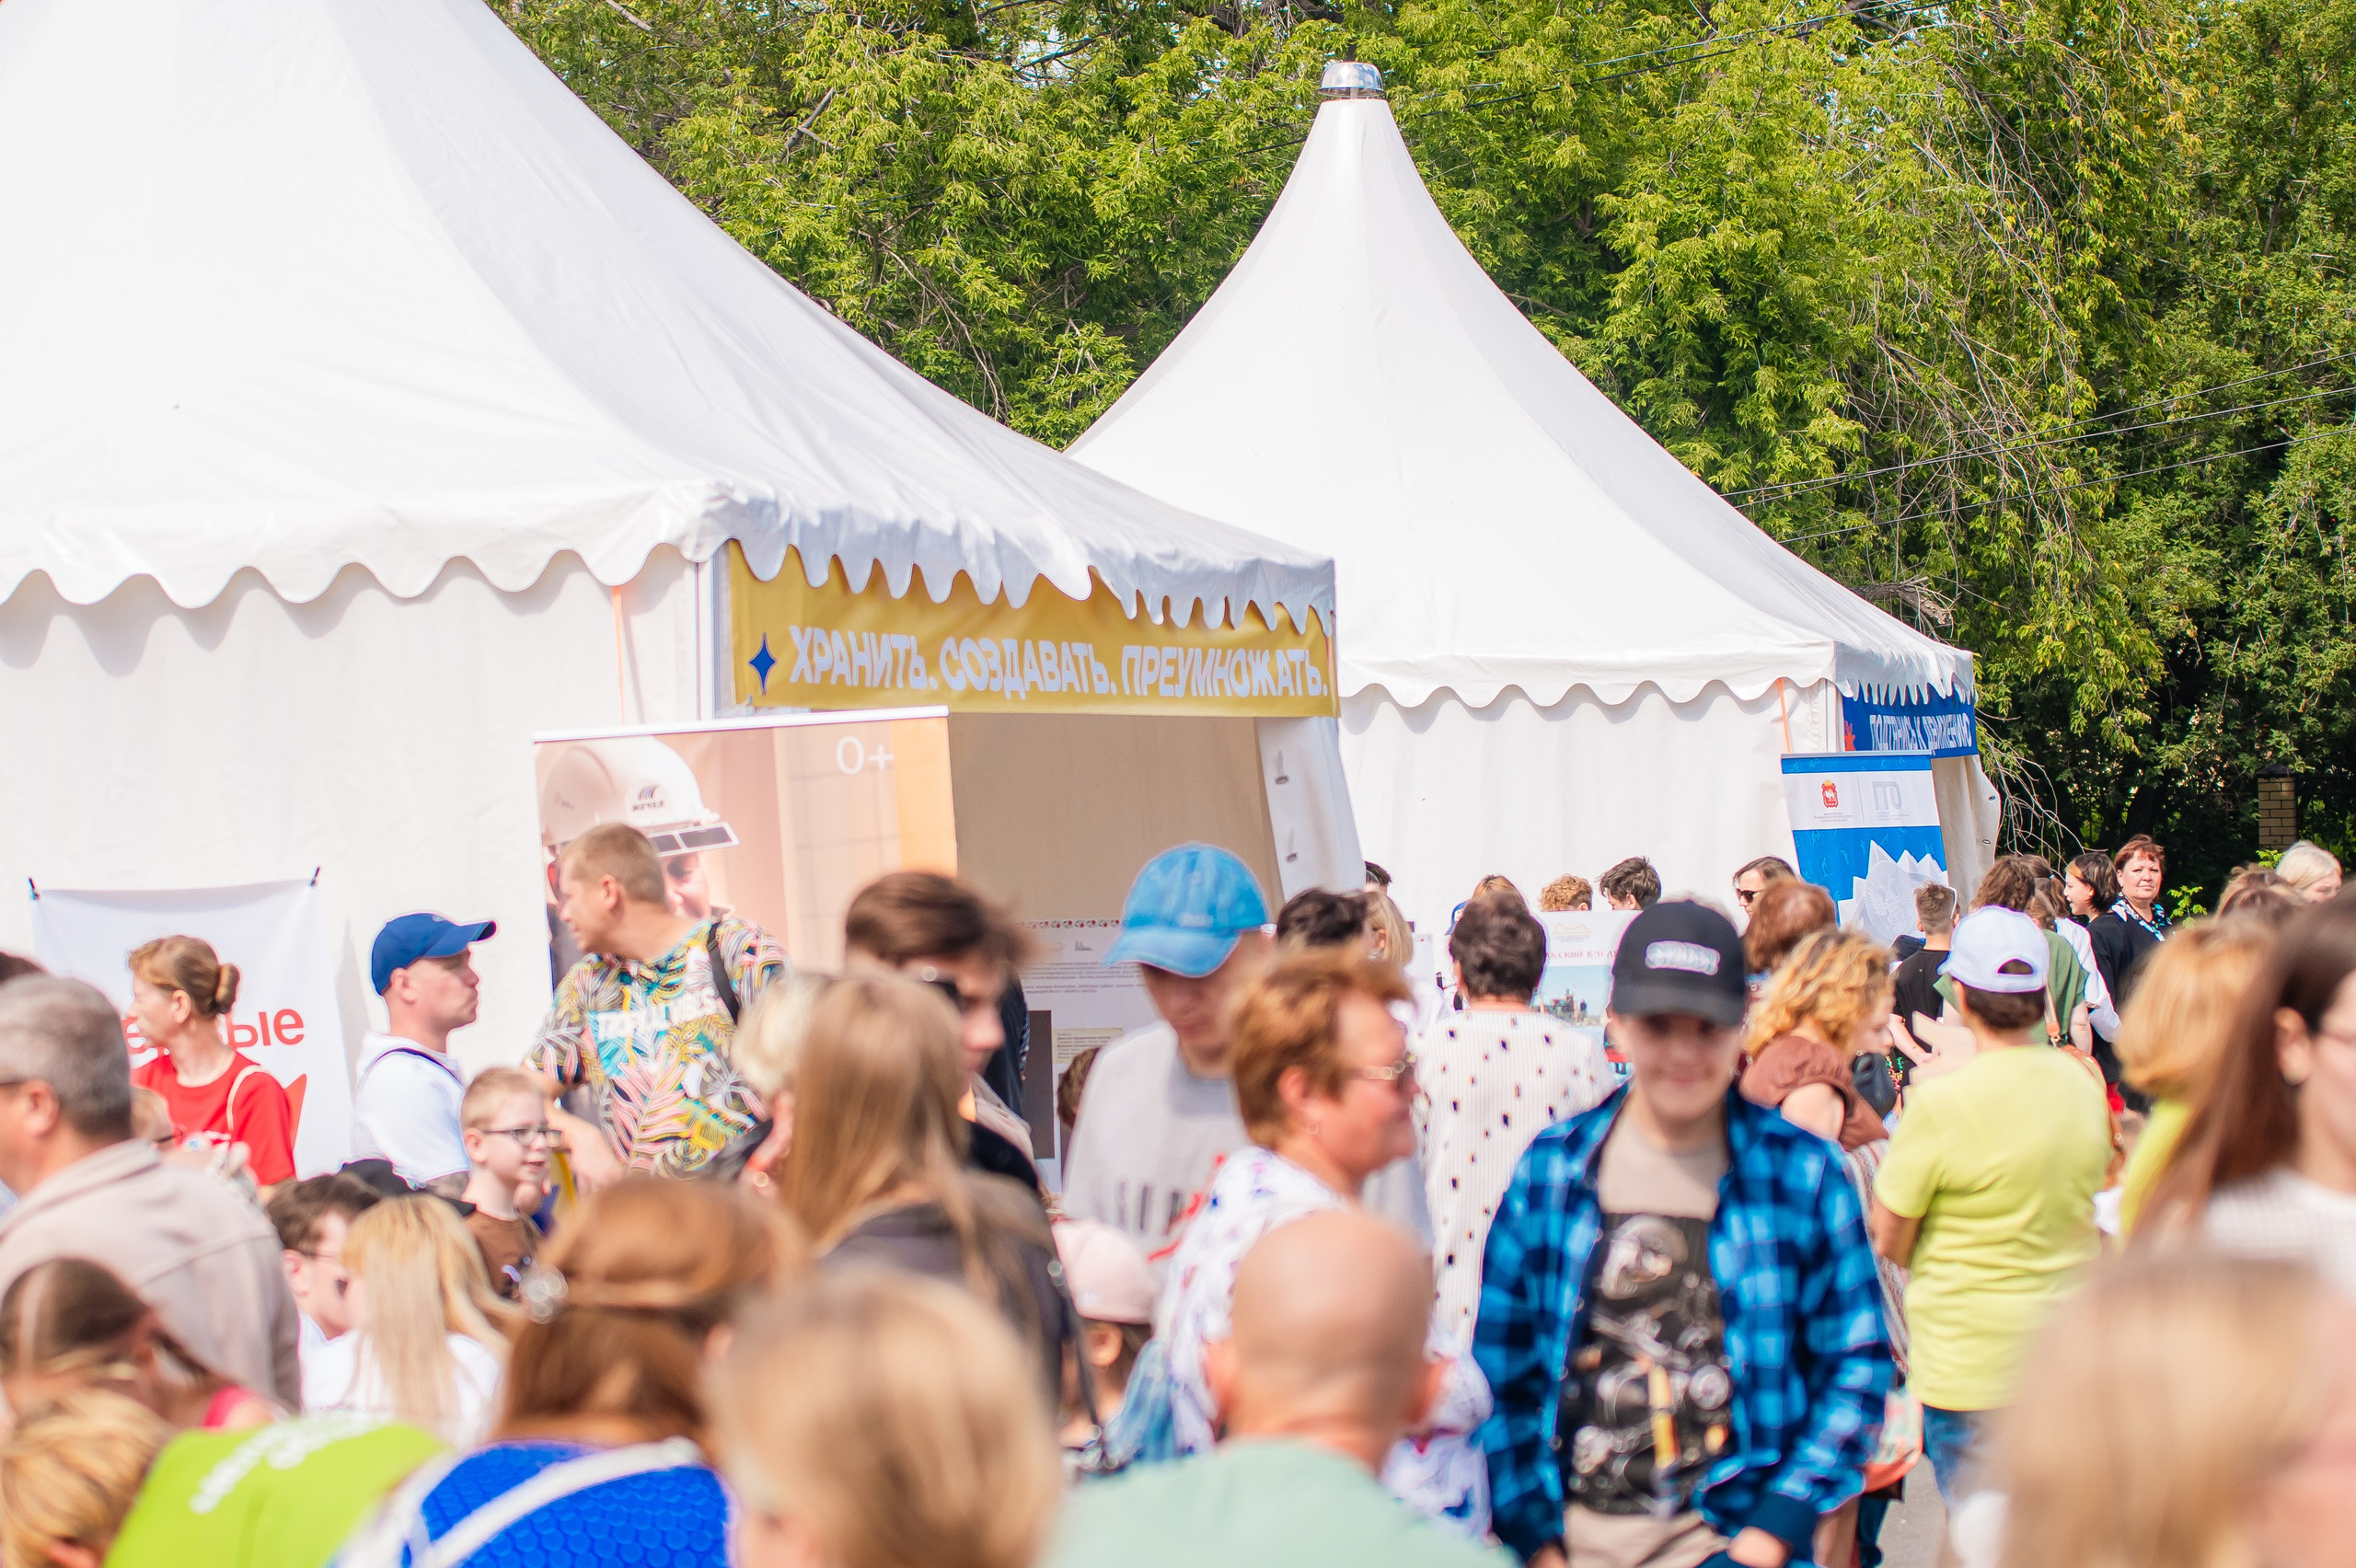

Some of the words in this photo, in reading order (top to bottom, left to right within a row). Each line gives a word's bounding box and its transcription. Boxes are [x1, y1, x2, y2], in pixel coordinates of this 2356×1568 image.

[788, 624, 939, 690] ХРАНИТЬ.
[939, 636, 1118, 700] СОЗДАВАТЬ.
[1121, 645, 1329, 698] ПРЕУМНОЖАТЬ.
[836, 735, 895, 775] 0+
